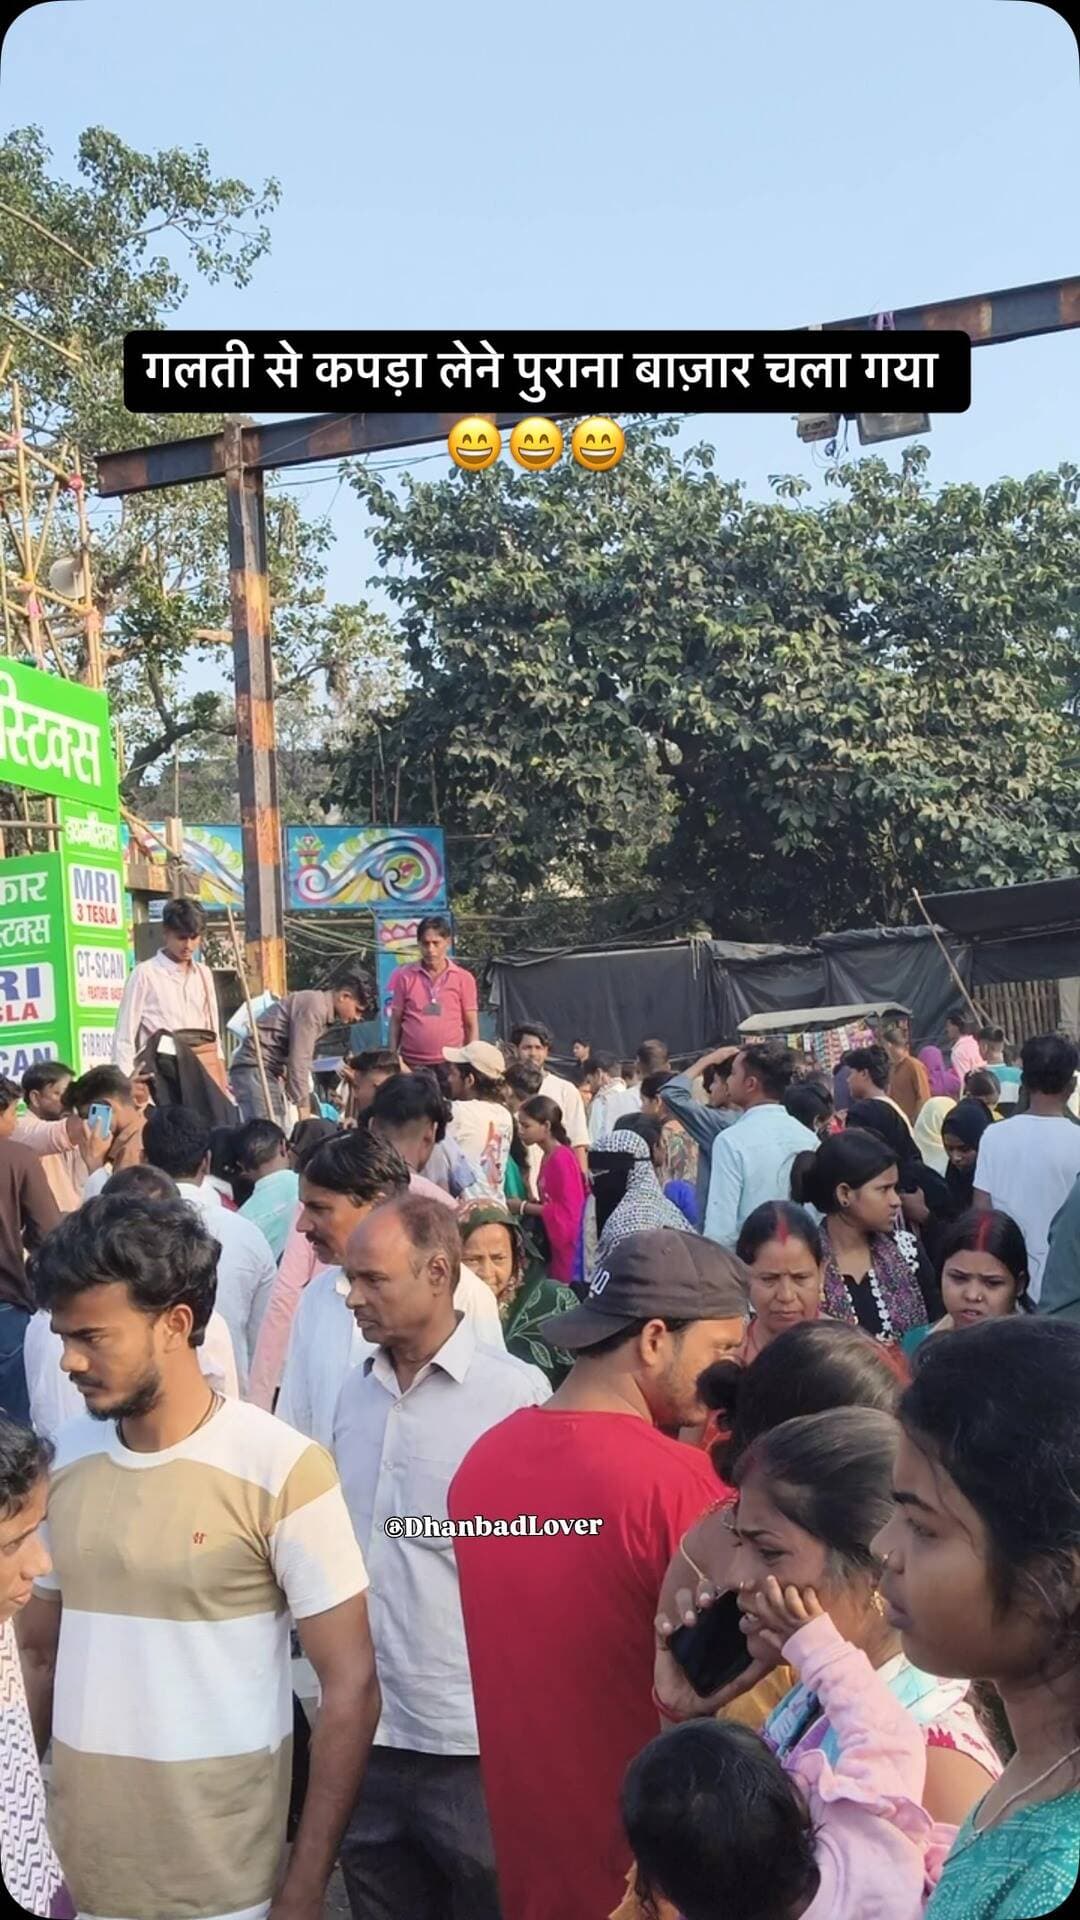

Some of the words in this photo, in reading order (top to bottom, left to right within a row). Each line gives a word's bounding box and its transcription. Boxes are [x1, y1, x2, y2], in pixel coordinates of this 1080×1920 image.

[73, 867, 117, 904] MRI
[77, 903, 84, 921] 3
[86, 904, 118, 925] TESLA
[77, 950, 124, 979] CT-SCAN
